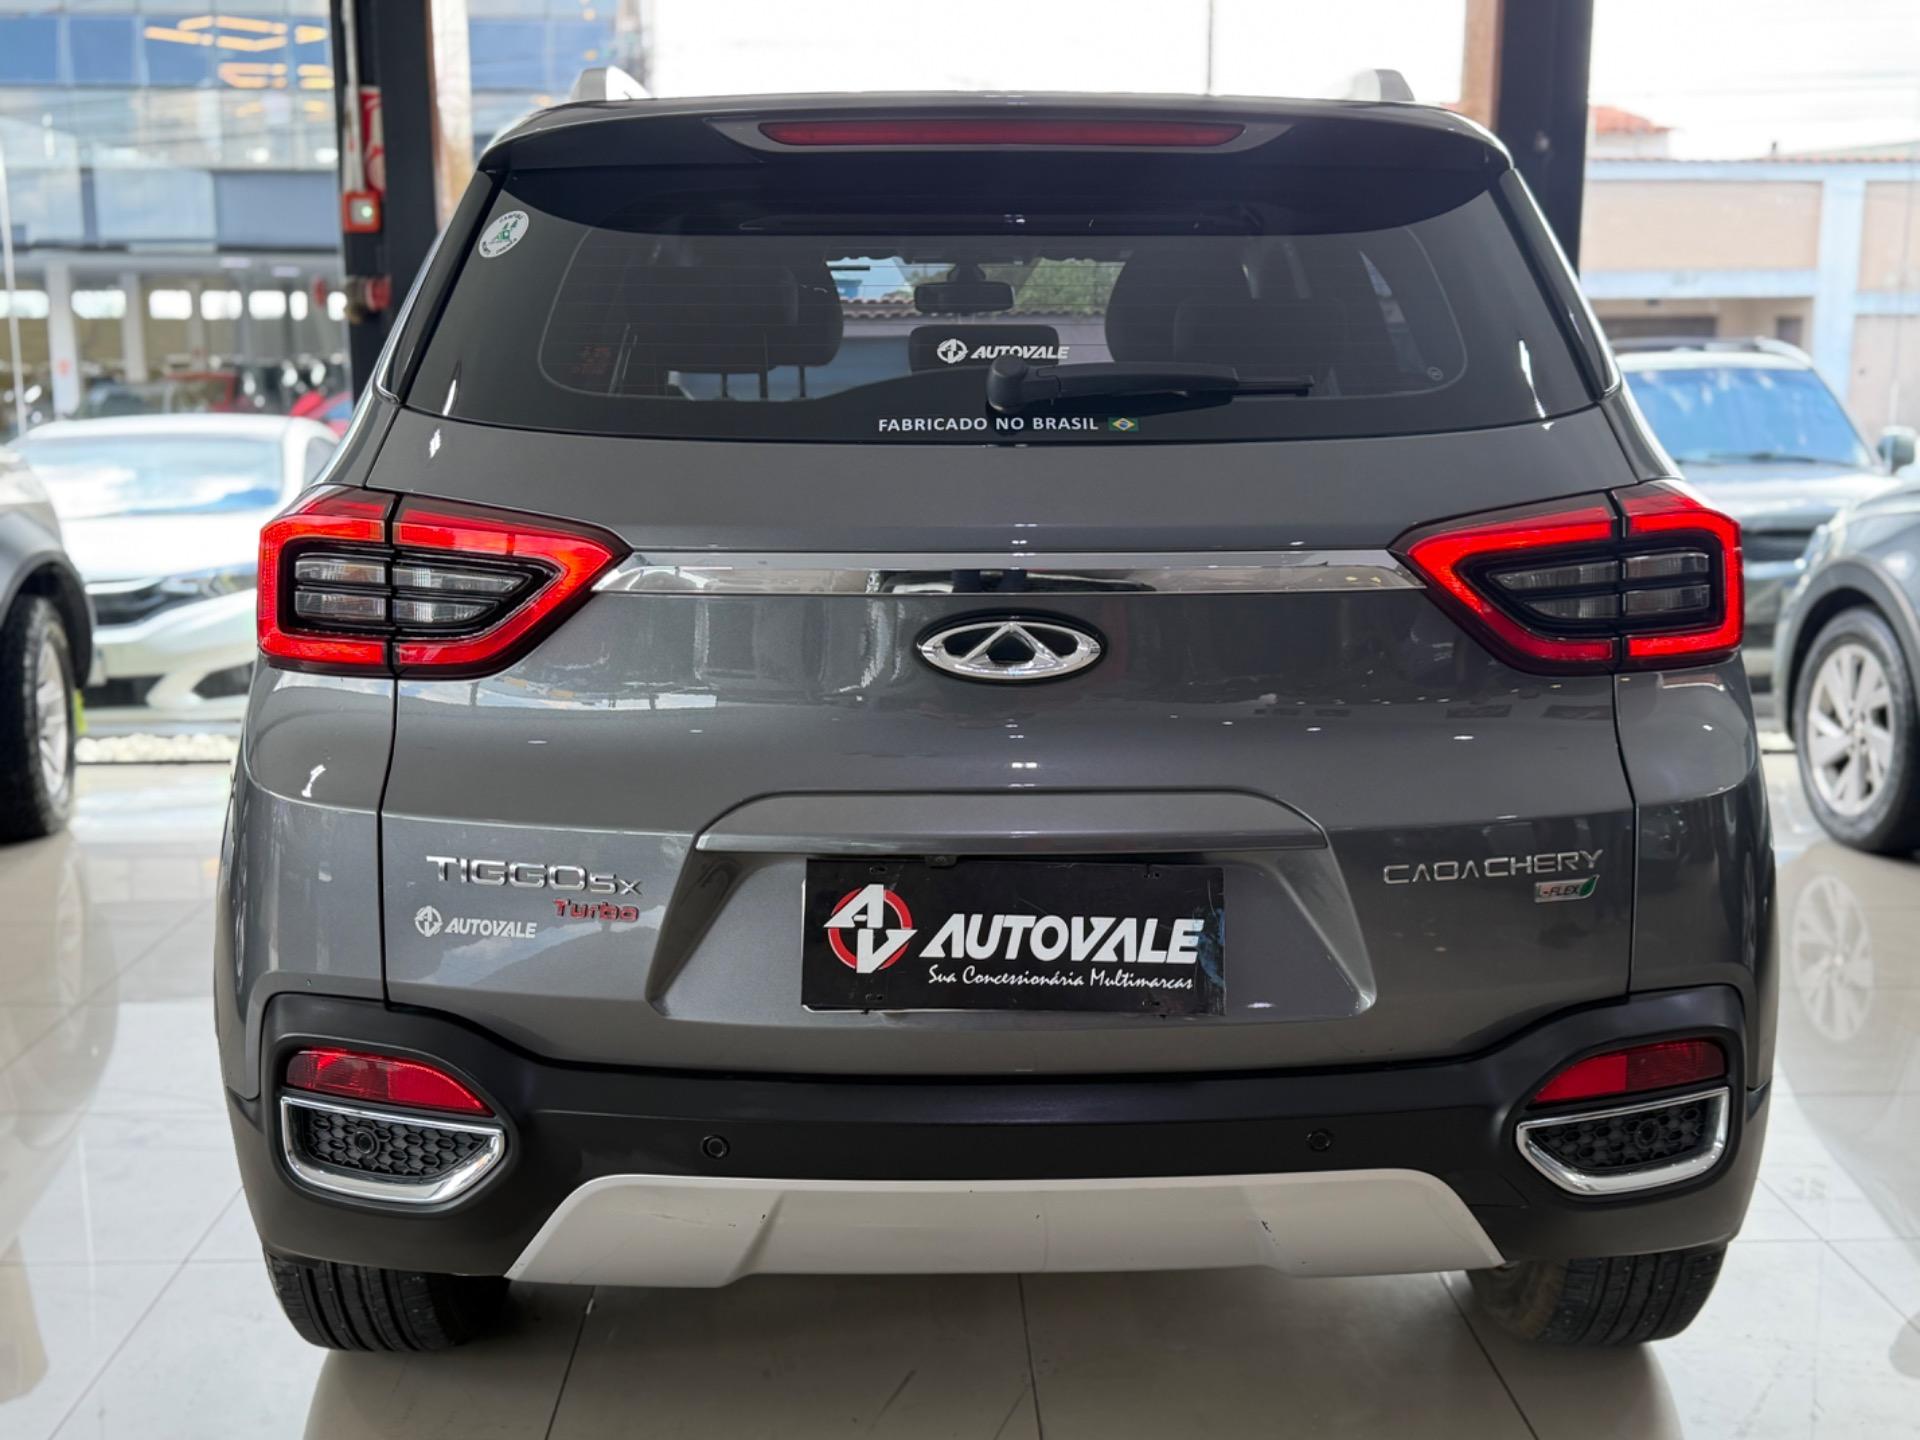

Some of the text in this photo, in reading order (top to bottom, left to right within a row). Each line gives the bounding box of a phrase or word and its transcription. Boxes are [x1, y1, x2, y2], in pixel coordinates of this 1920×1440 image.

[970, 345, 1070, 359] AUTOVALE
[878, 417, 1099, 431] FABRICADO NO BRASIL
[553, 898, 640, 923] Turbo
[445, 917, 537, 938] AUTOVALE
[918, 913, 1204, 964] AUTOVALE
[928, 964, 1194, 990] Sua Concessionária Multimarcas
